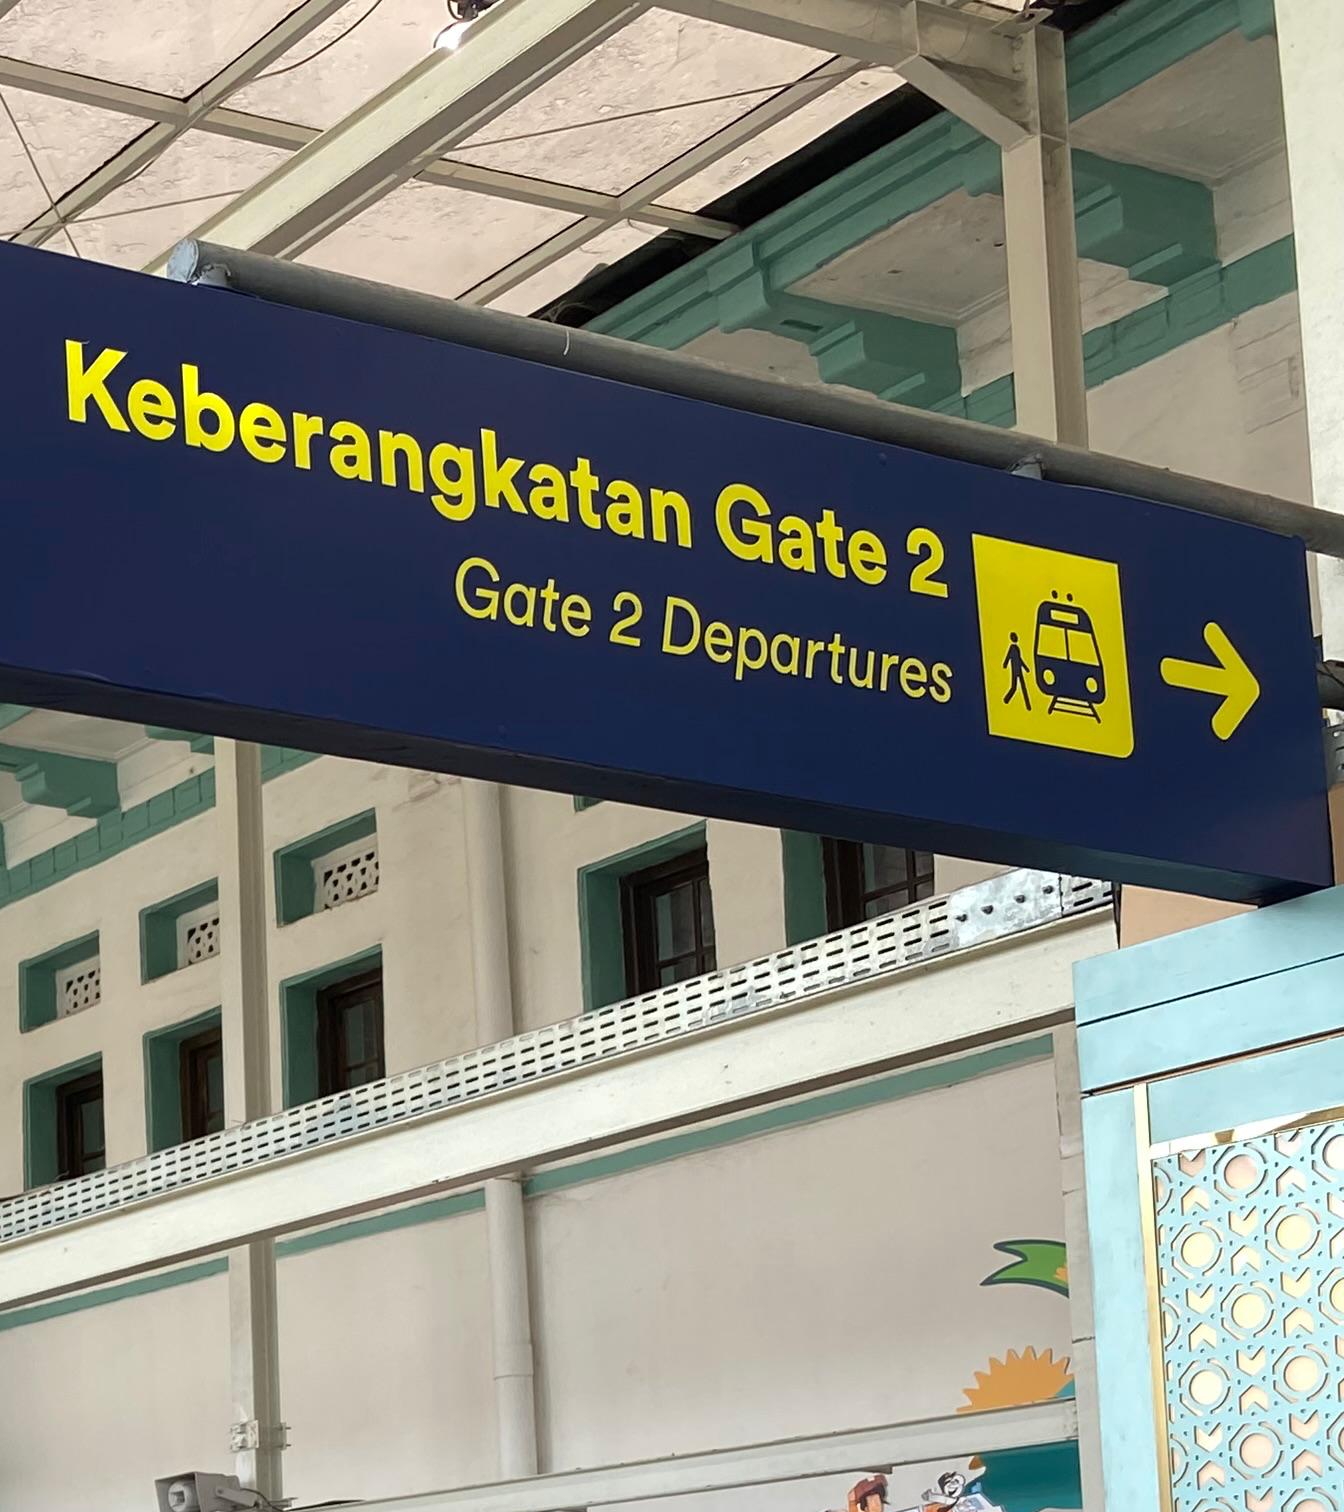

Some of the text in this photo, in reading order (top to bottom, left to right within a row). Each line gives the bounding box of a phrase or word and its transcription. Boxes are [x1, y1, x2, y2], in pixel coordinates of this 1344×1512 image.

[62, 337, 952, 600] Keberangkatan Gate 2
[454, 557, 956, 709] Gate 2 Departures
